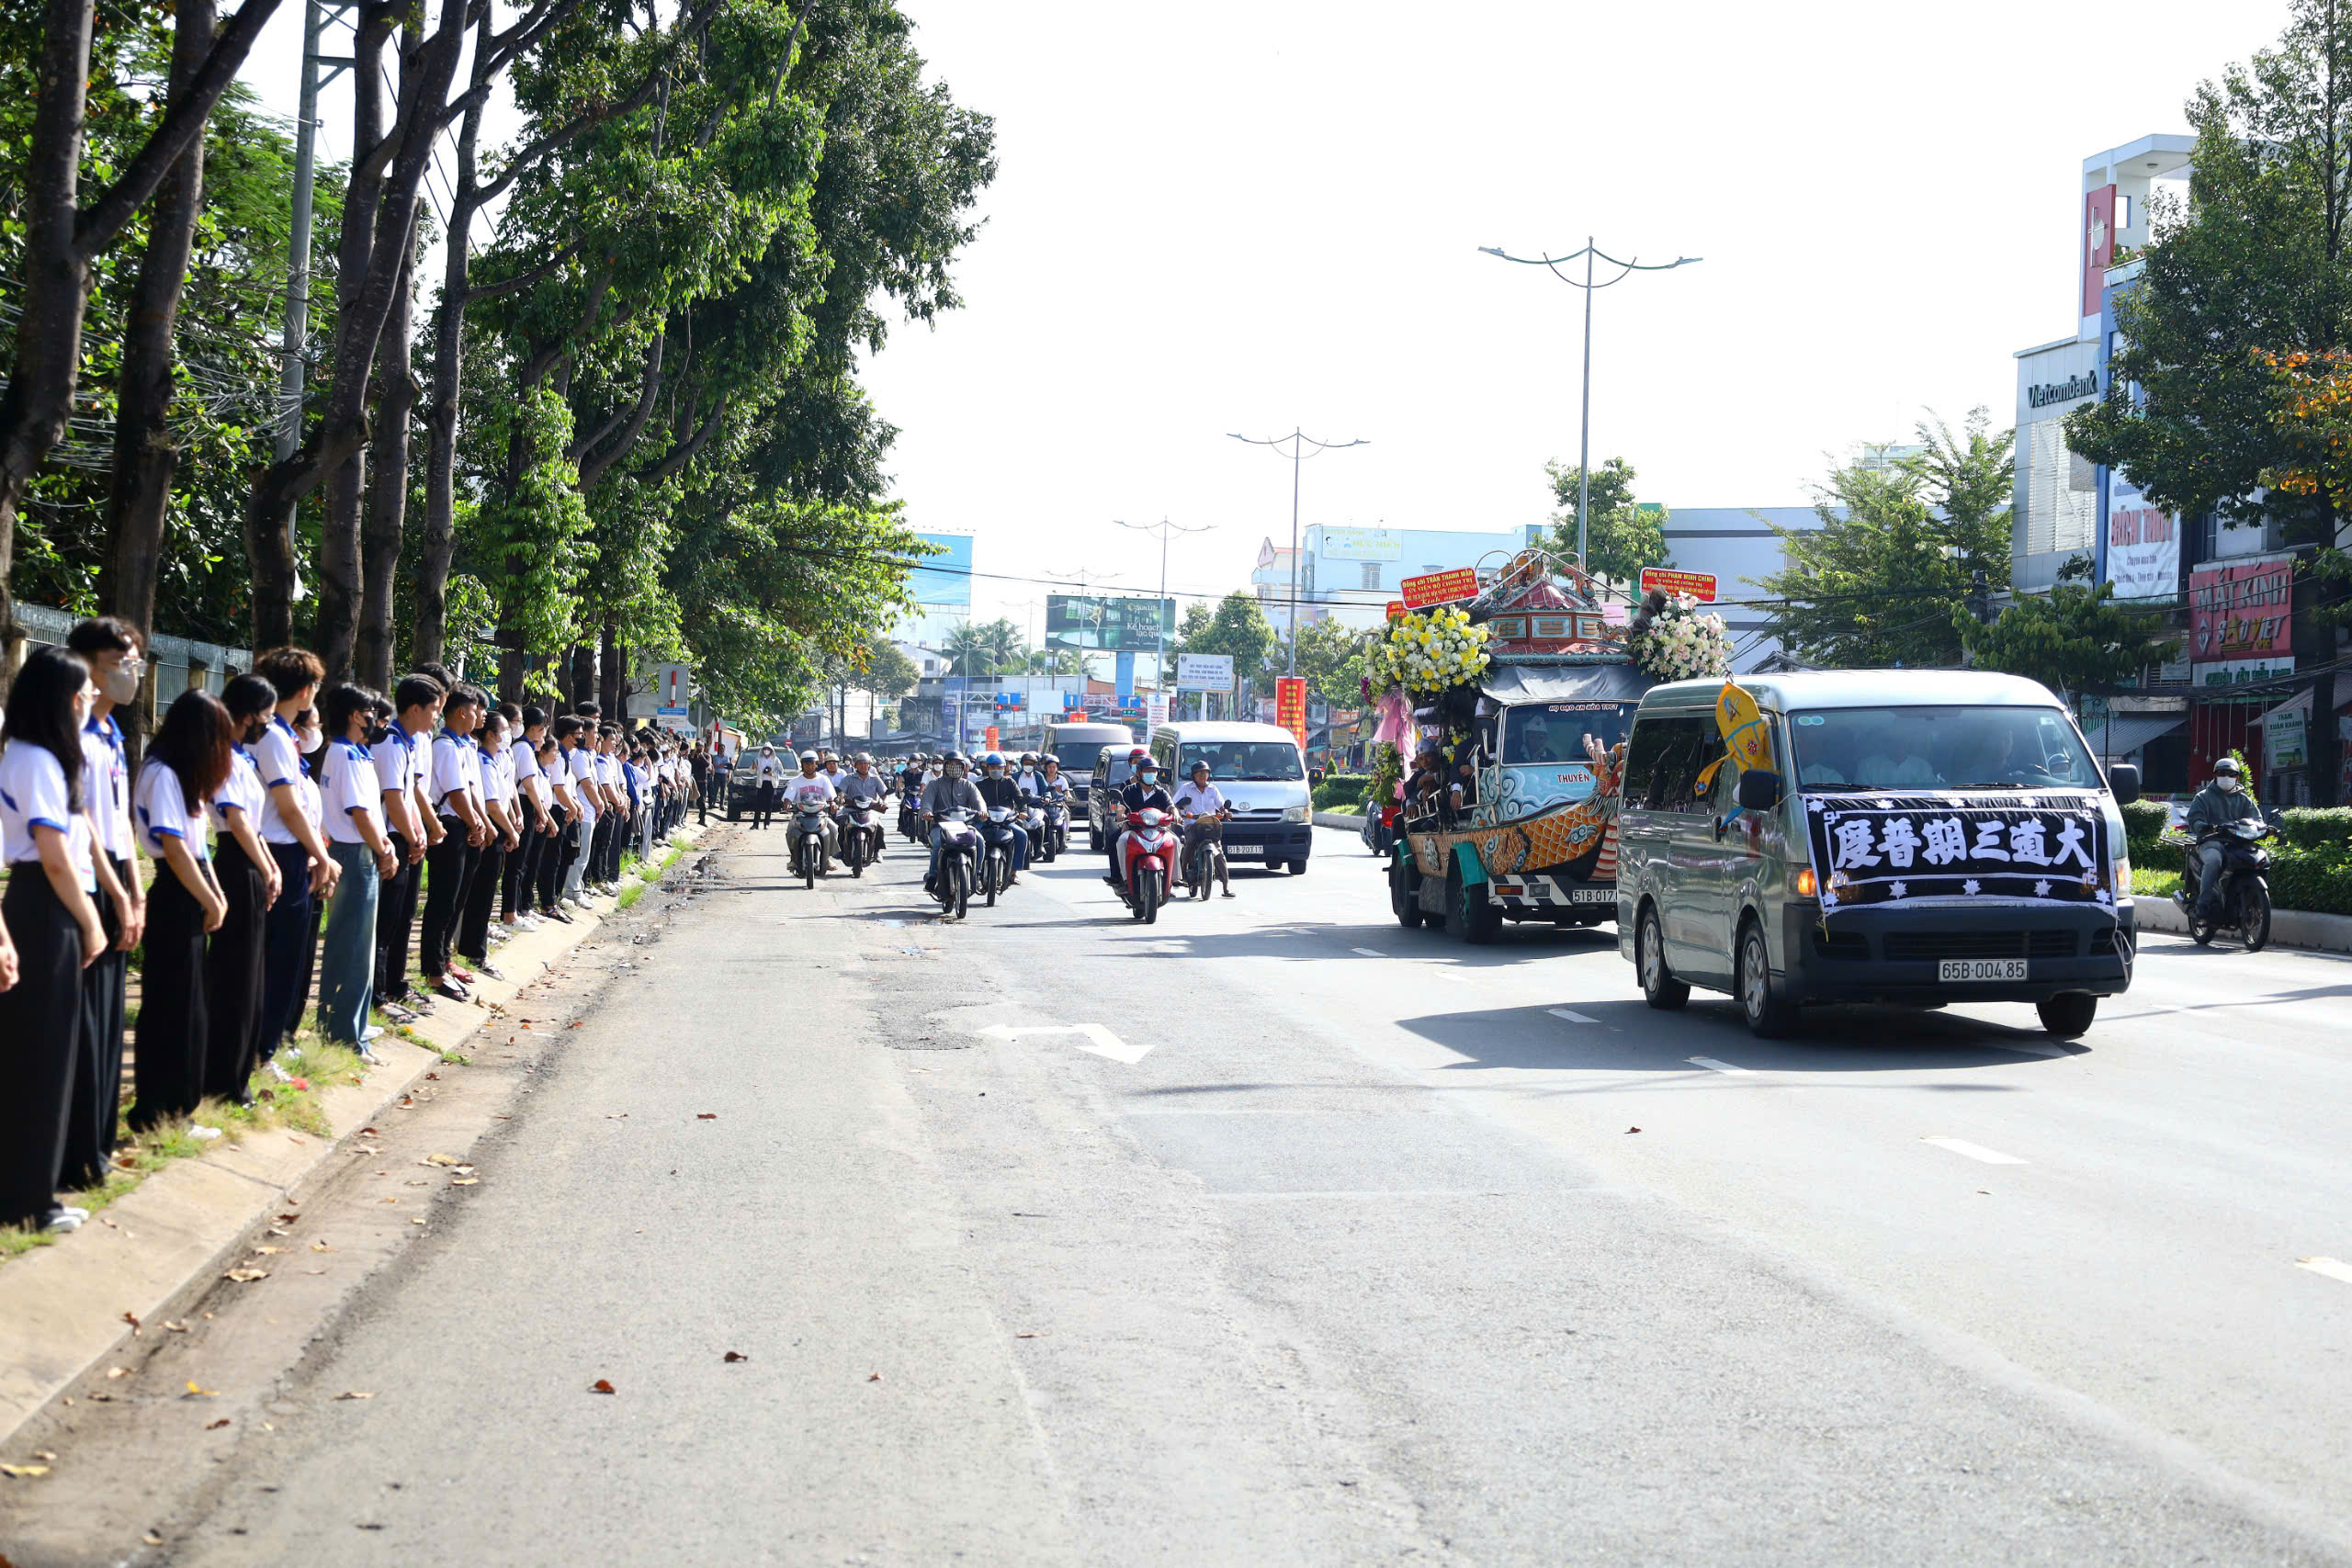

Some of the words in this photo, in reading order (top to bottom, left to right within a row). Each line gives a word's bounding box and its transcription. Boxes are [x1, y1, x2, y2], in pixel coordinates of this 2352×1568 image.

[2028, 369, 2098, 408] Vietcombank
[1557, 770, 1589, 783] THUYỀN
[1941, 961, 2025, 980] 65B-004.85
